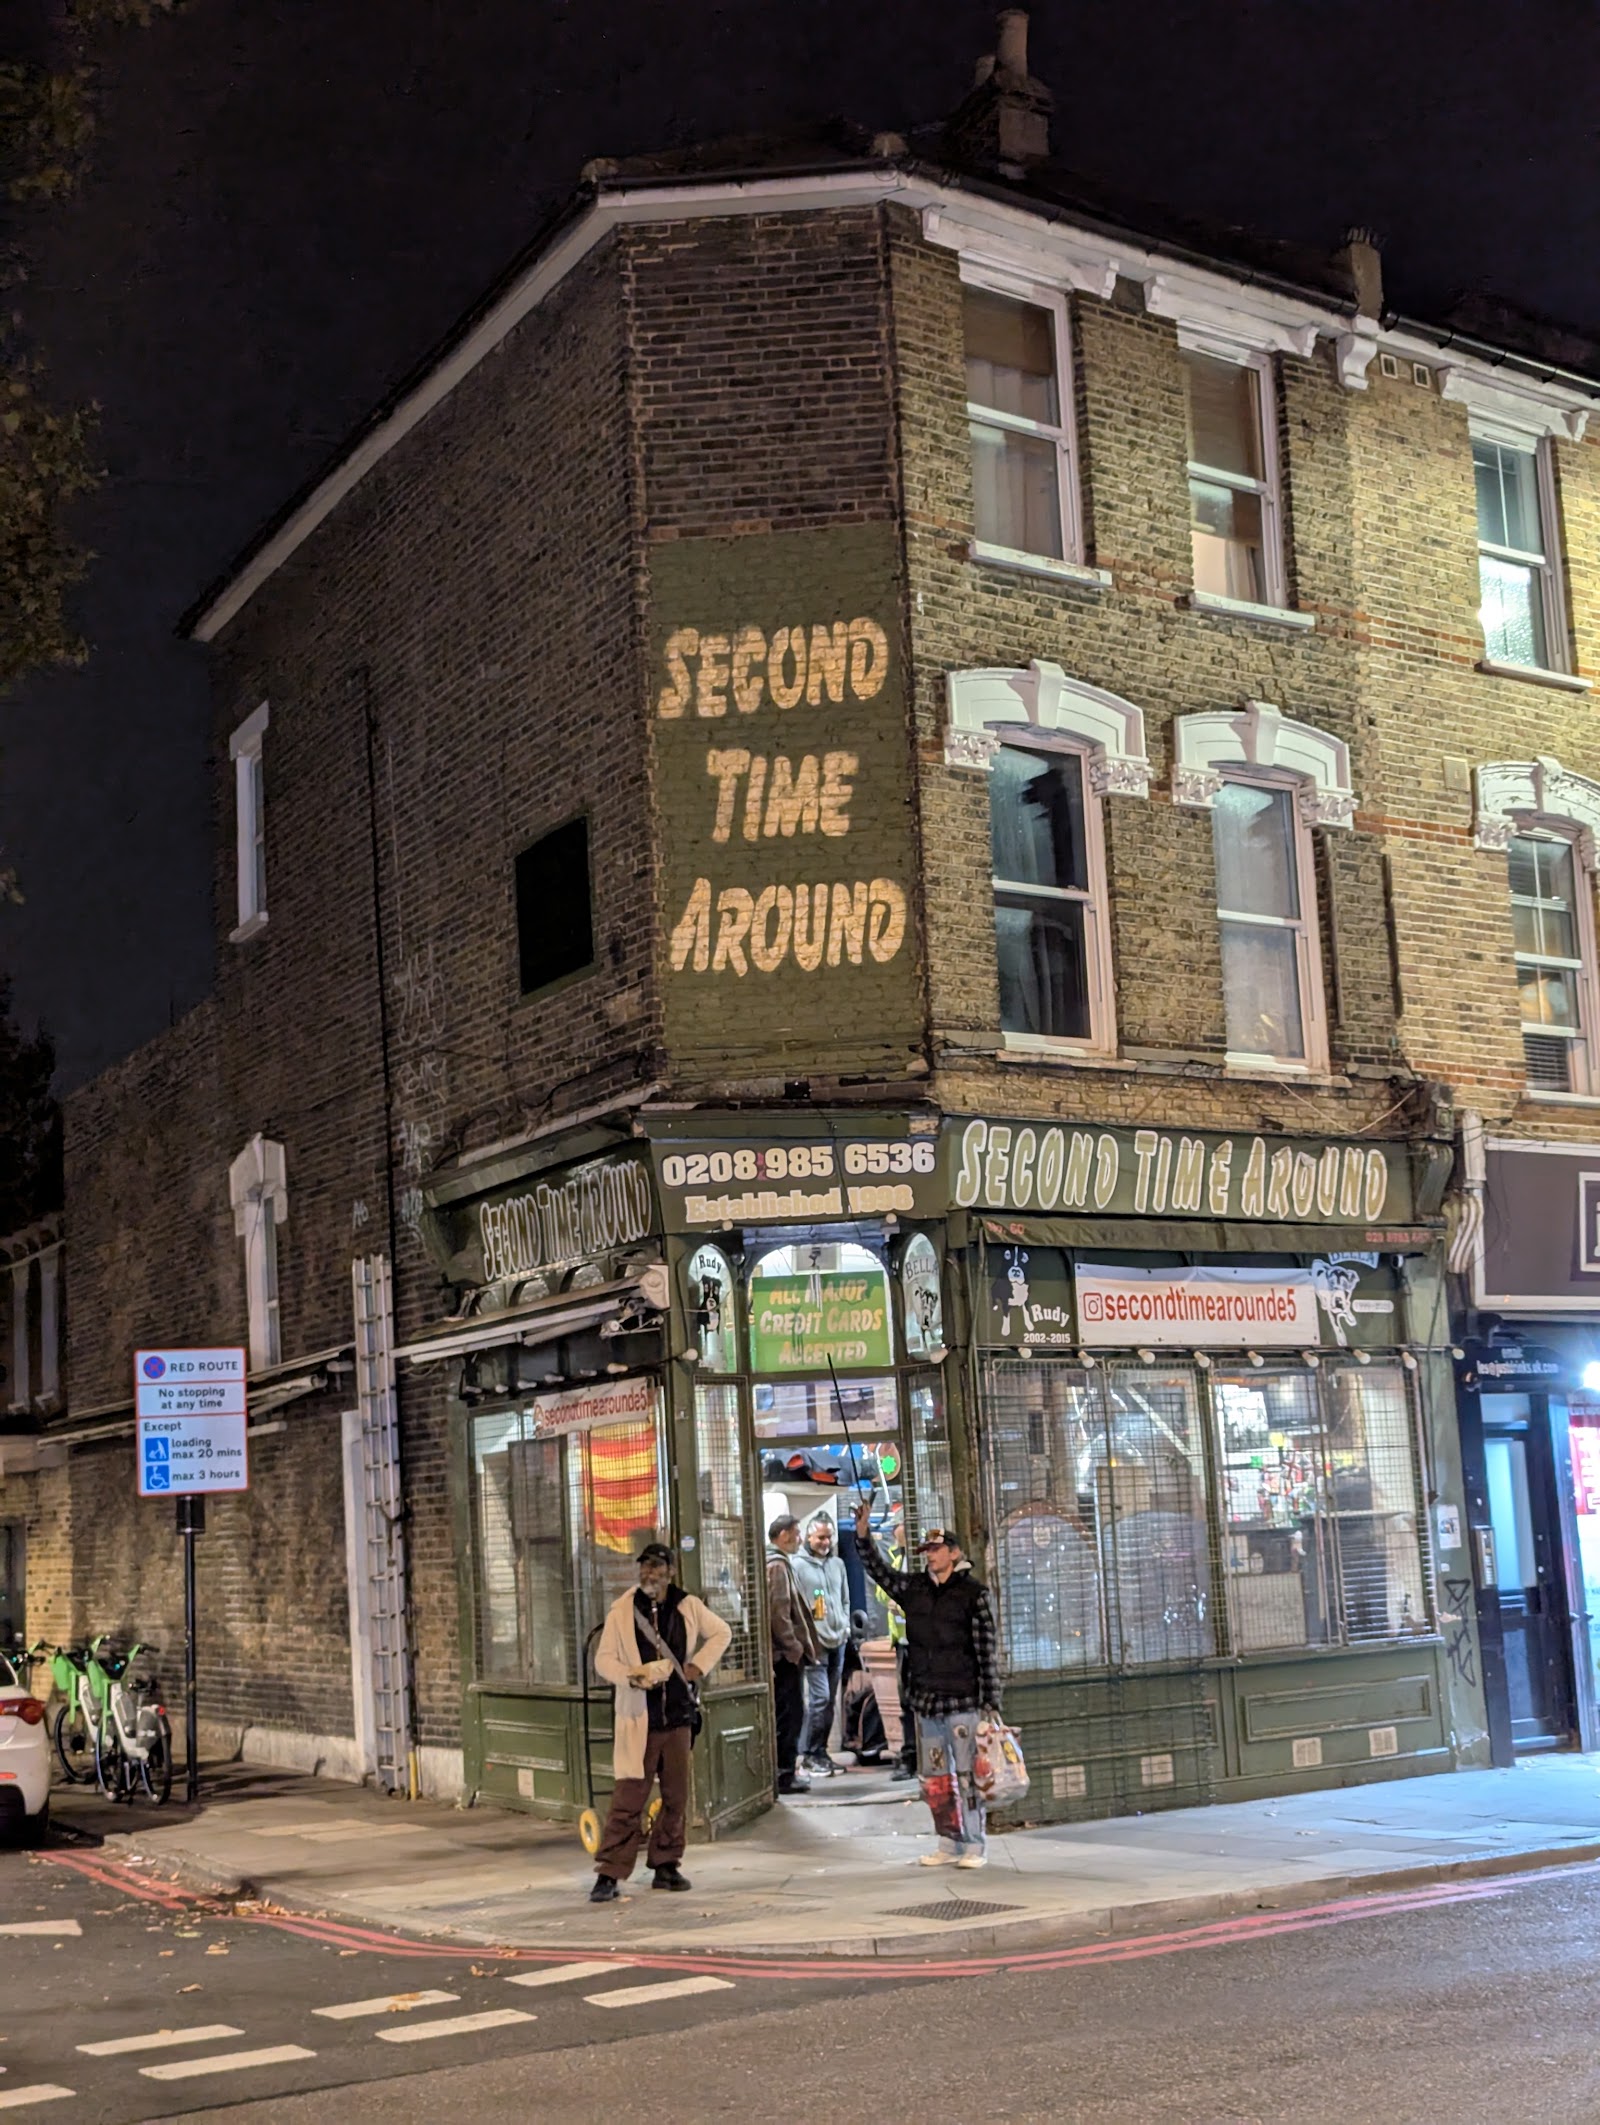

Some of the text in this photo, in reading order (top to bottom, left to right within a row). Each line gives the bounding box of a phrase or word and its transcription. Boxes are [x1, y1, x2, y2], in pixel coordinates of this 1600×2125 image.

[657, 616, 888, 719] SECOND
[706, 748, 859, 842] TIME
[670, 876, 906, 977] AROUND
[662, 1142, 936, 1187] 0208 985 6536
[956, 1119, 1388, 1222] SECOND TIME AROUND
[685, 1184, 914, 1223] Established 1998
[480, 1193, 542, 1281] SECOND
[536, 1183, 583, 1264] TIME
[580, 1159, 652, 1253] AROUND
[698, 1254, 722, 1273] Rudy
[905, 1257, 939, 1280] BELLA
[769, 1282, 801, 1304] ALL
[1105, 1287, 1297, 1323] secondtimearounde5
[760, 1306, 883, 1335] CREDIT CARDS
[1031, 1304, 1070, 1328] Rudy
[779, 1340, 868, 1365] ACCEPTED
[170, 1361, 238, 1372] RED ROUTE
[158, 1387, 226, 1397] No stopping
[161, 1399, 223, 1410] at any time
[144, 1421, 182, 1432] Except
[171, 1438, 212, 1448] loading
[172, 1447, 242, 1459] max 20 mins
[199, 1471, 206, 1480] 3
[210, 1469, 240, 1479] hours
